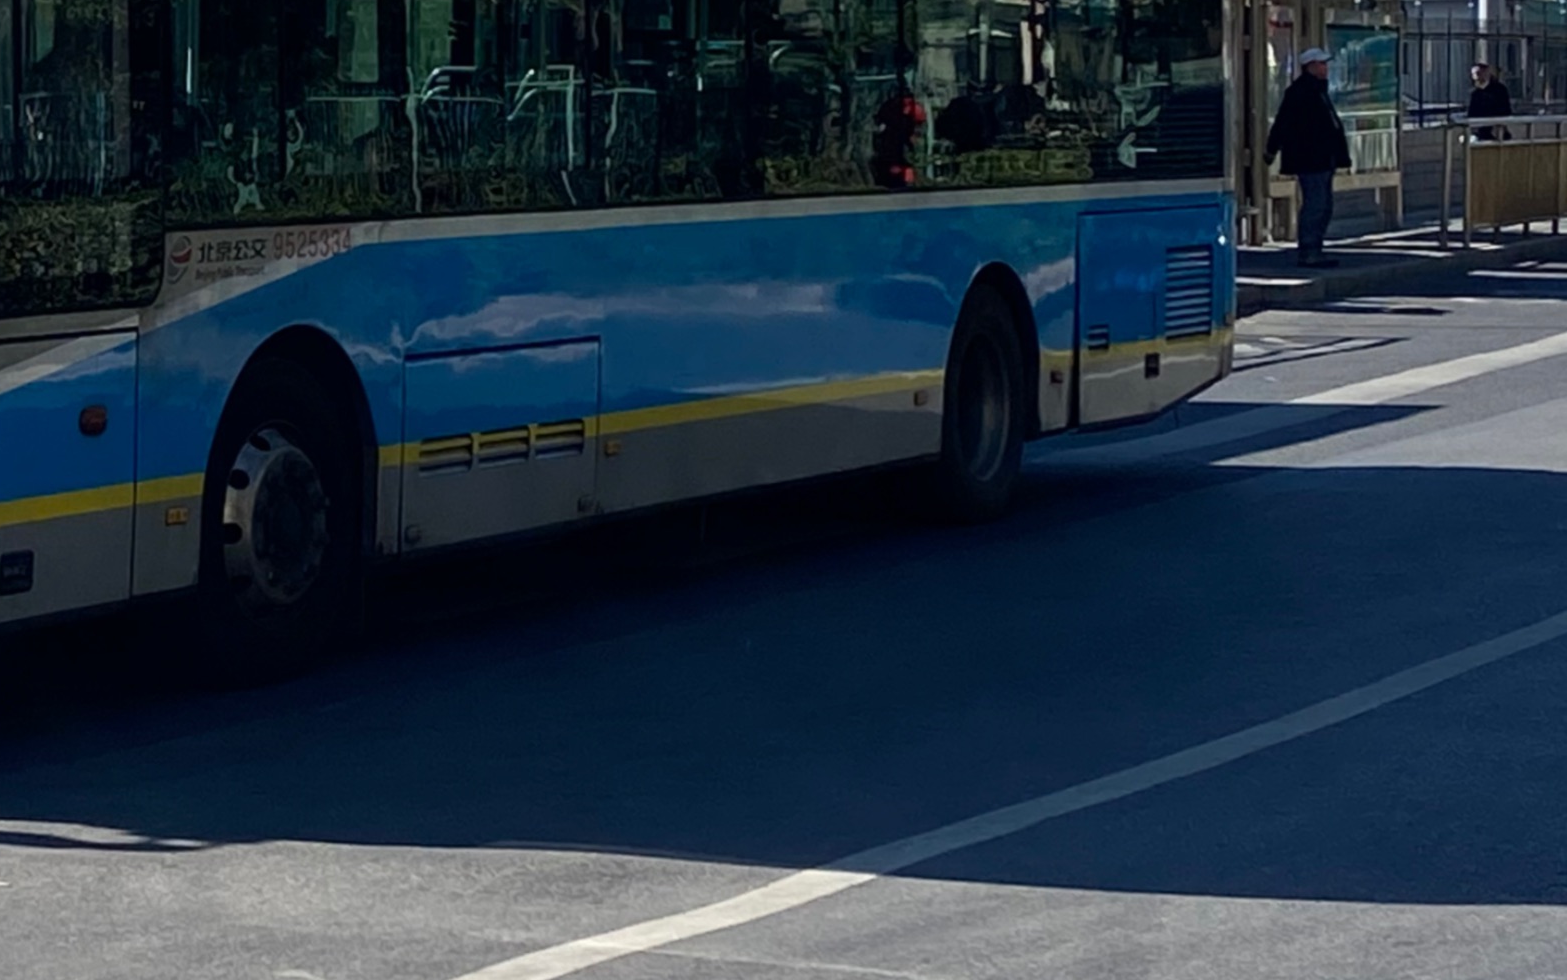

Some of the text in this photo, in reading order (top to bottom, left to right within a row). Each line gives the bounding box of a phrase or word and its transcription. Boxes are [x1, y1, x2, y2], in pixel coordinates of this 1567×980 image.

[197, 238, 269, 263] 北京公交
[273, 227, 352, 260] 9525334
